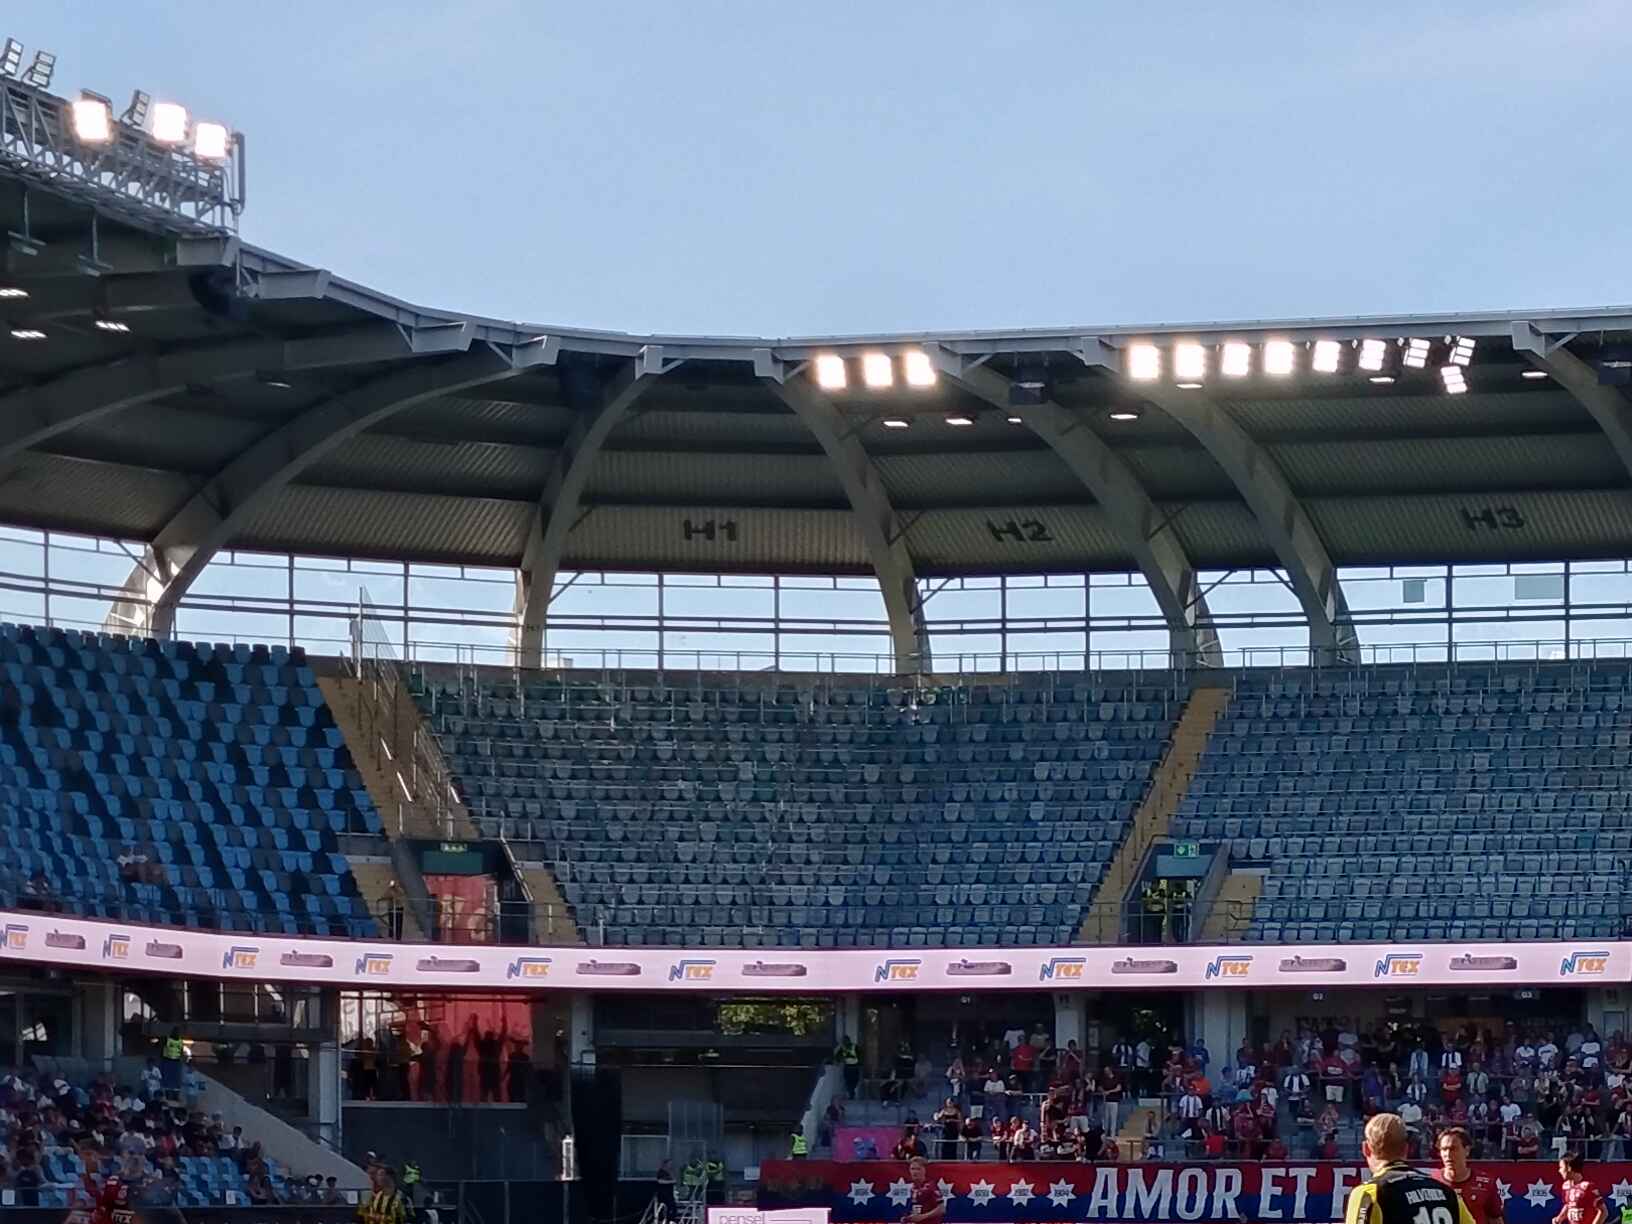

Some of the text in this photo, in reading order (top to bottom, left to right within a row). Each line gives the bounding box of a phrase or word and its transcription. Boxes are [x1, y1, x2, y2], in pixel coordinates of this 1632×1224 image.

[683, 519, 737, 541] H1
[1461, 507, 1525, 531] H3
[988, 520, 1054, 542] H2
[1086, 1168, 1243, 1219] AMOR
[1258, 1168, 1317, 1219] ET
